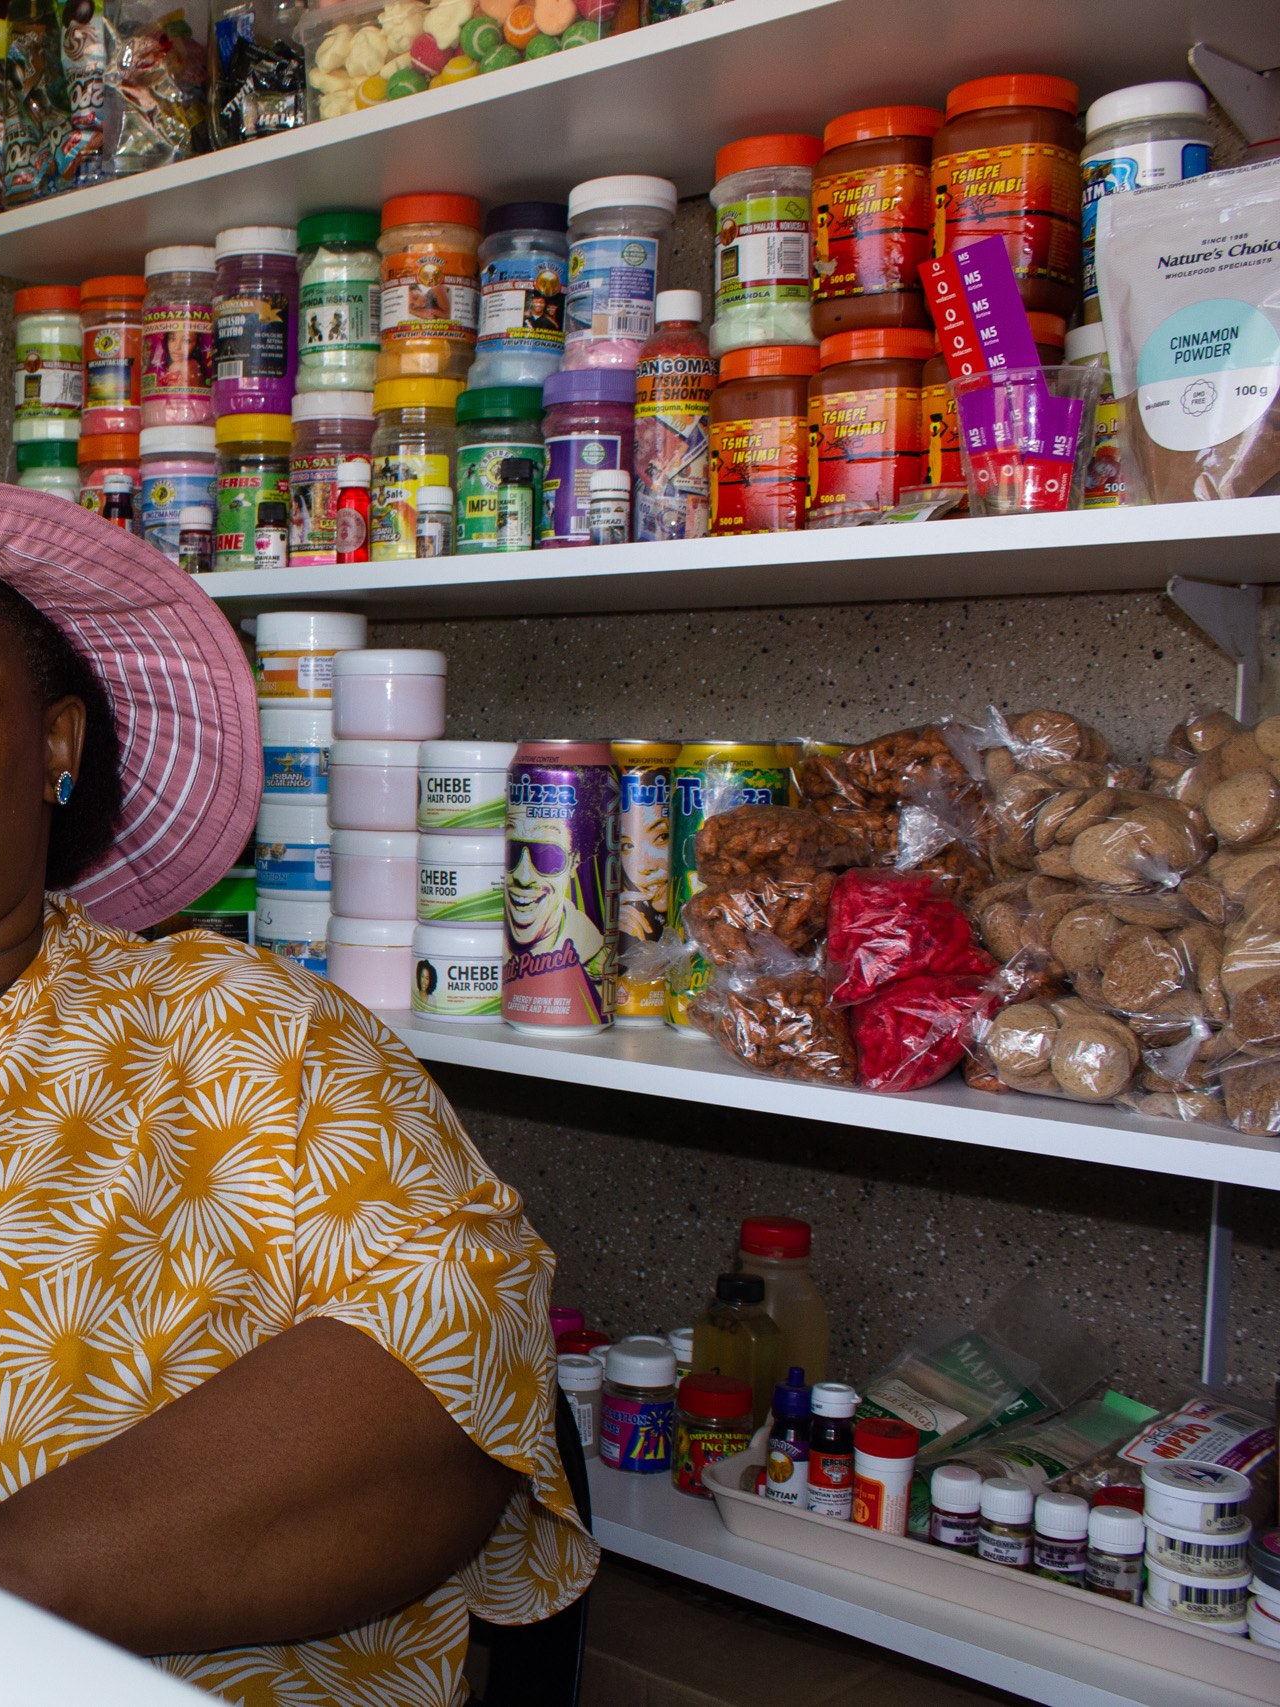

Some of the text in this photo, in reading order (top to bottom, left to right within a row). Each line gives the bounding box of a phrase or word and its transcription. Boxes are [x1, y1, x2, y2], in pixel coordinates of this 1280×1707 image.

[951, 163, 1001, 185] TSHEPE
[833, 183, 876, 204] TSHEPE
[963, 177, 1023, 198] INSIMBI
[1201, 237, 1226, 245] SINCE
[958, 252, 970, 262] M5
[1158, 248, 1223, 269] Nature's
[1165, 258, 1272, 280] WHOLEFOOD SPECIALISTS
[830, 273, 856, 284] 500 GR
[964, 270, 981, 285] M5
[936, 293, 956, 303] vodacom
[972, 298, 989, 313] M5
[944, 320, 964, 331] vodacom
[980, 326, 997, 340] M5
[1170, 326, 1239, 350] CINNAMON
[952, 348, 972, 358] vodacom
[1175, 343, 1231, 364] POWDER
[988, 354, 1005, 368] M5
[1235, 386, 1267, 396] 100 g
[822, 406, 868, 425] TSHEPE
[834, 420, 887, 438] INSIMBI
[993, 422, 1006, 442] M5
[721, 434, 762, 451] TSHEPE
[969, 428, 982, 448] M5
[1053, 435, 1067, 456] M5
[732, 448, 781, 464] INSIMBI
[386, 489, 404, 499] Salt
[1059, 473, 1068, 501] vodacom
[468, 499, 497, 513] IMPU
[820, 494, 846, 504] 500 GR
[720, 517, 744, 526] 500 GR
[427, 777, 471, 793] CHEBE
[621, 774, 670, 811] Twi
[427, 794, 471, 804] HAIR FOOD
[526, 806, 576, 818] ENERGY
[421, 869, 457, 886] CHEBE
[435, 887, 457, 897] FOOD
[517, 937, 579, 978] Punch
[447, 965, 499, 981] CHEBE
[447, 982, 499, 992] HAIR FOOD
[512, 994, 571, 1006] ENERGY DRINK WITH
[650, 991, 664, 999] ENER
[528, 1004, 541, 1012] AND
[542, 1005, 570, 1014] TAURINE
[640, 999, 664, 1007] CAFFEIN
[701, 1442, 748, 1452] INCENSE
[1151, 1423, 1212, 1460] MPEPO
